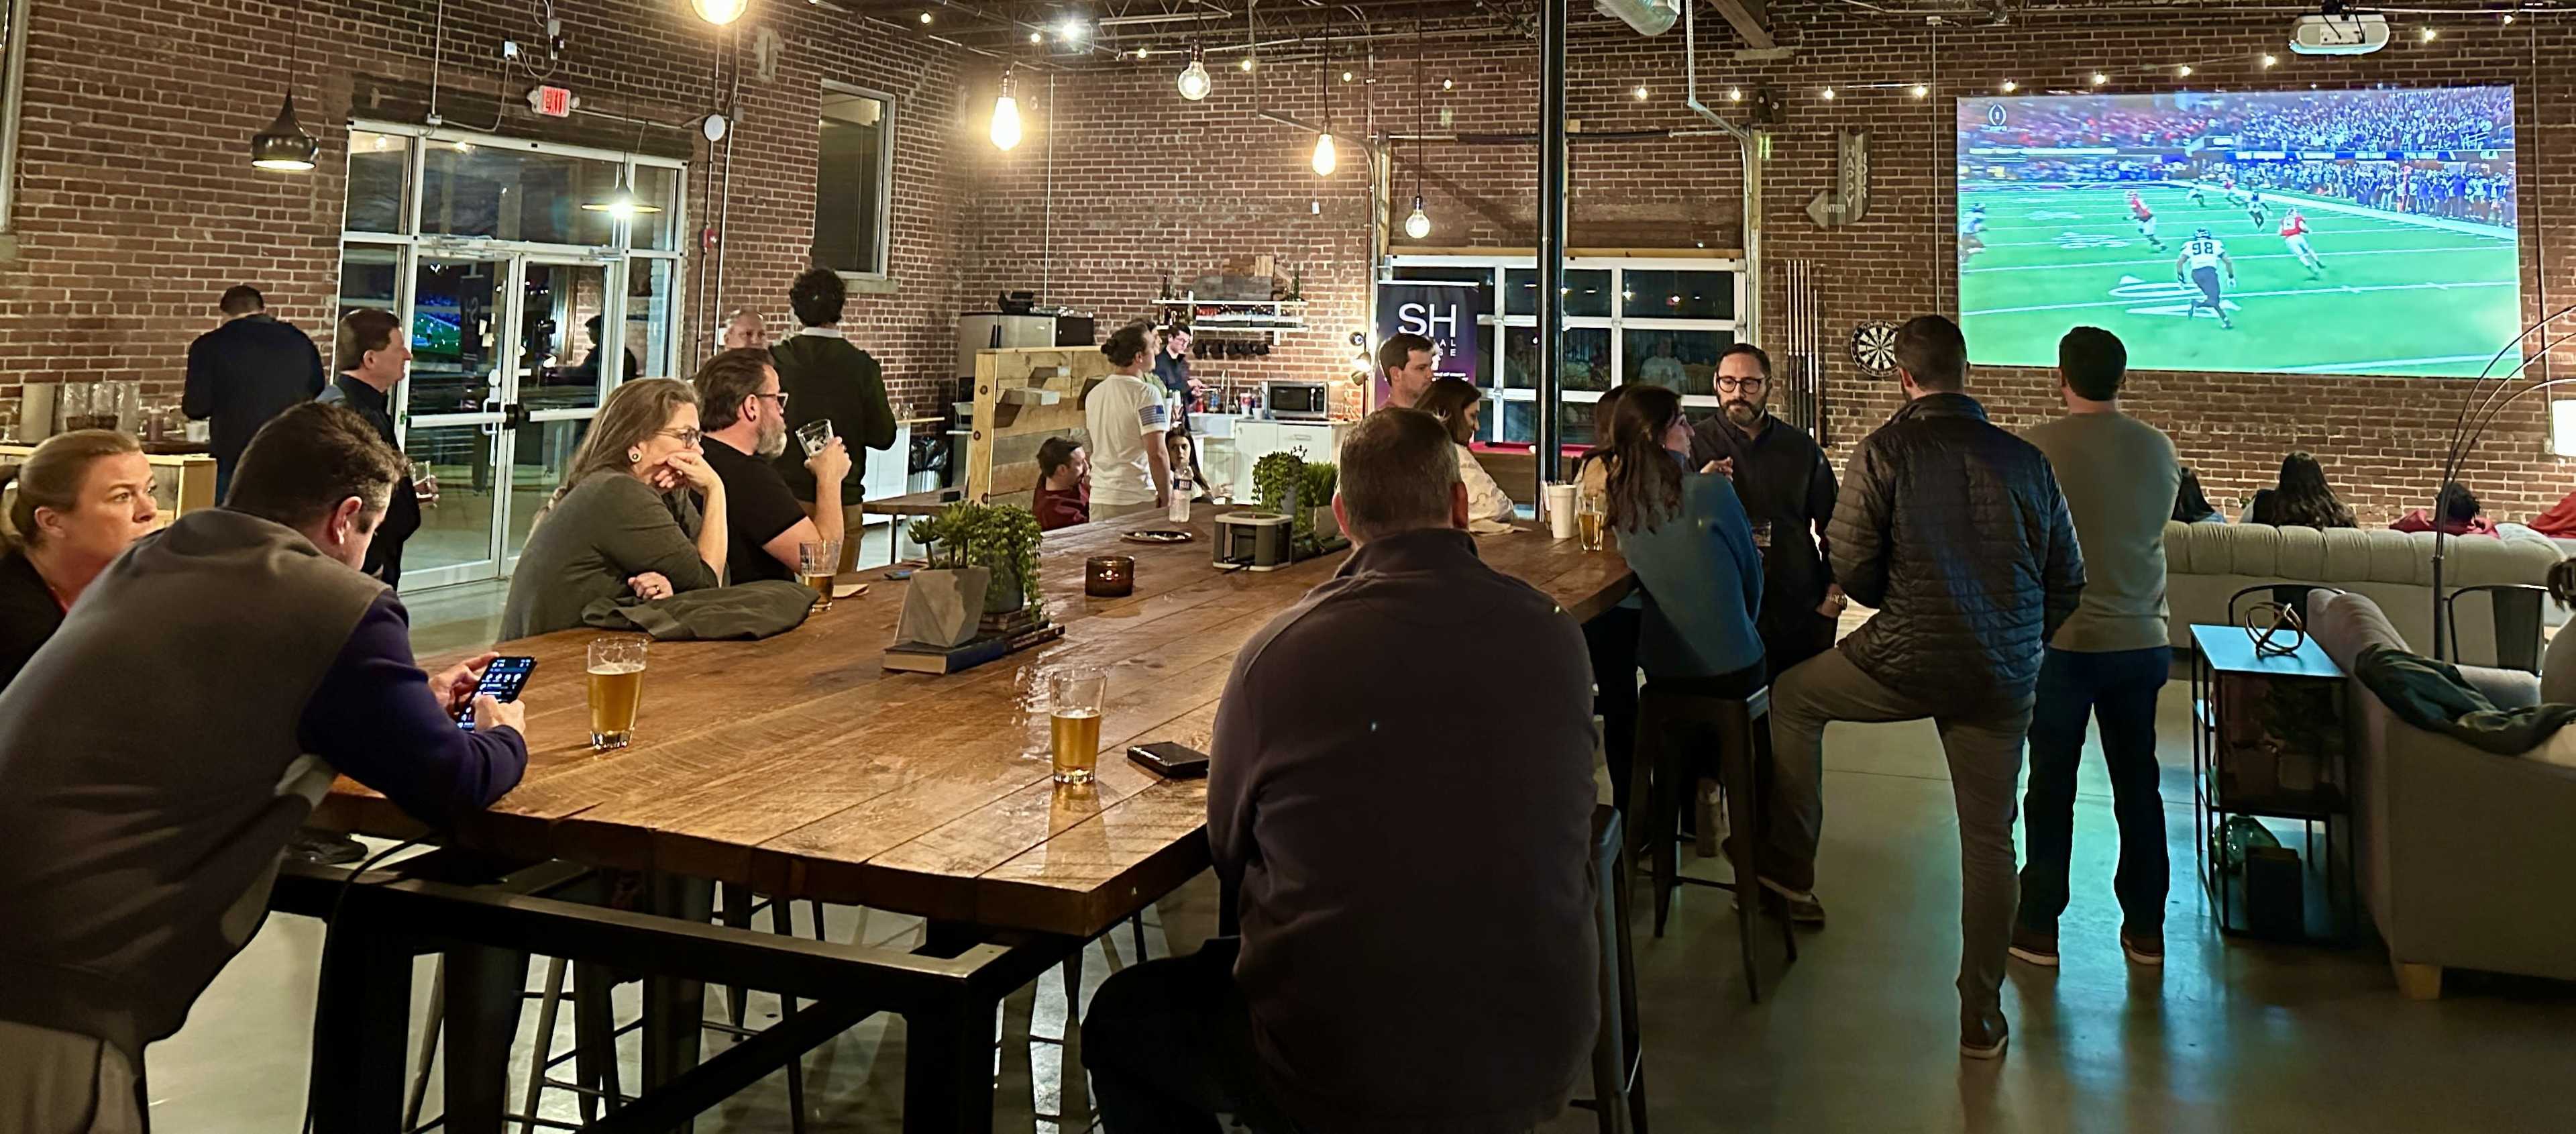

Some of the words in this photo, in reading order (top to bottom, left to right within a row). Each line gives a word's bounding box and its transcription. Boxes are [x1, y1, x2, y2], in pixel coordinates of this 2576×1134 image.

[543, 89, 567, 114] EXIT
[1845, 144, 1856, 207] HAPPY
[1821, 203, 1846, 213] ENTER
[2192, 242, 2214, 255] 98
[1397, 303, 1457, 338] SH
